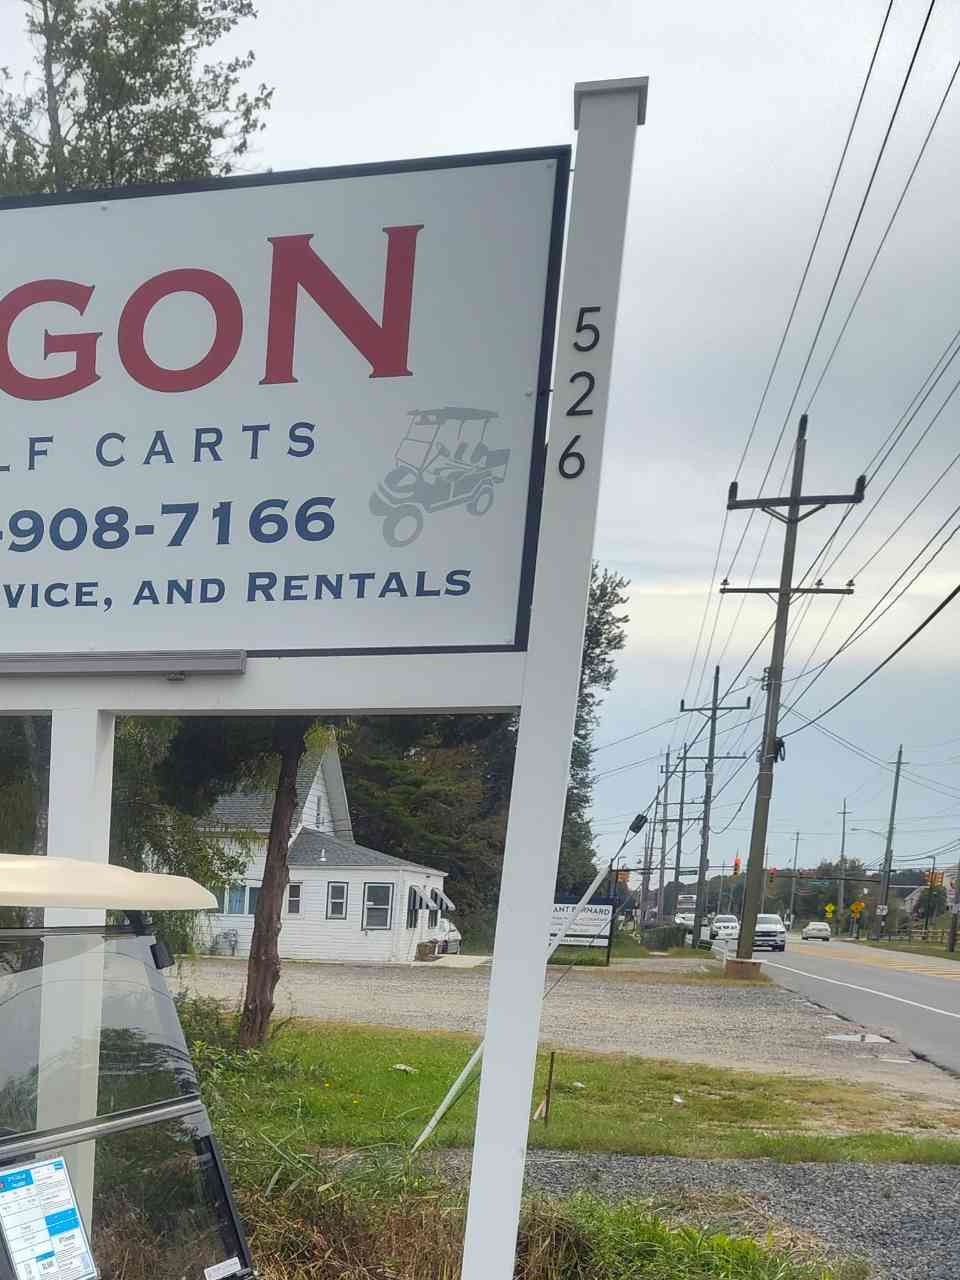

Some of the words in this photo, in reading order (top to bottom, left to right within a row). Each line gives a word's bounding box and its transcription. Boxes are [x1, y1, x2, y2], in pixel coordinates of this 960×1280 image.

[557, 306, 602, 479] 526
[95, 421, 317, 468] CARTS
[132, 577, 226, 606] AND
[246, 569, 472, 603] RENTALS
